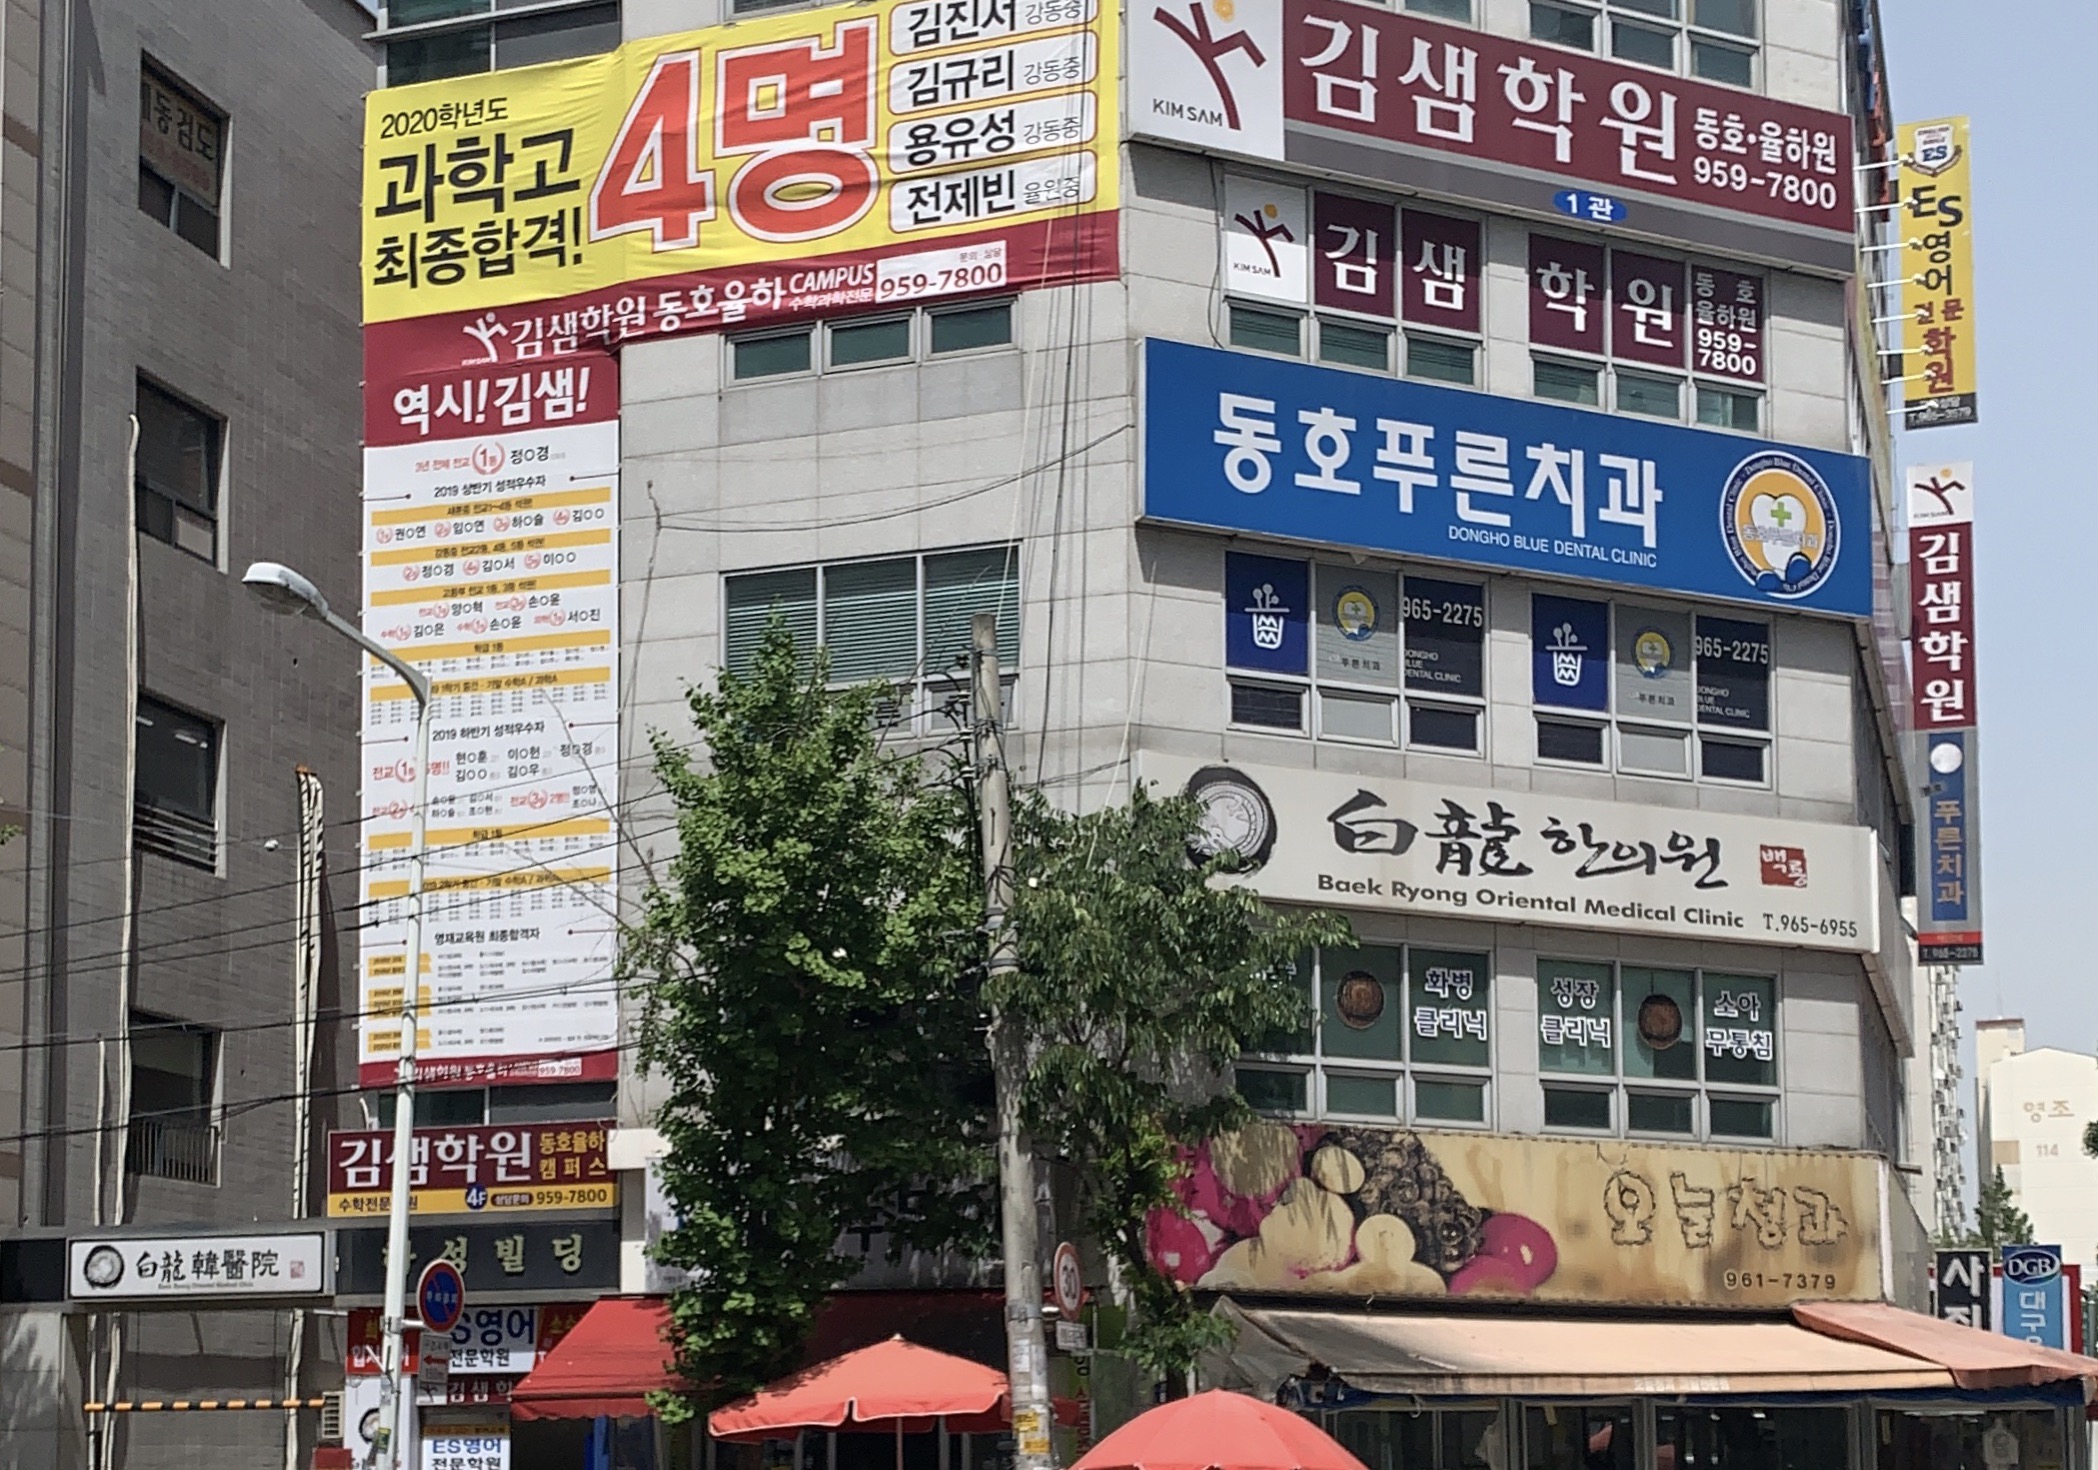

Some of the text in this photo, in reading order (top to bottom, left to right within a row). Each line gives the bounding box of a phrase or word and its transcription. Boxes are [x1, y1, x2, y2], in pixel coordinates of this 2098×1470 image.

[908, 0, 1015, 48] 김진서
[907, 50, 1081, 107] 김규리 강동중
[1300, 13, 1678, 185] 김샘학원
[380, 97, 509, 139] 2020학년도
[588, 13, 880, 254] 4명
[905, 110, 1081, 166] 용유성 강동중
[374, 128, 581, 224] 과학고
[1693, 156, 1837, 210] 959-7800
[907, 170, 1015, 225] 전제빈
[373, 206, 583, 290] 최종합격!
[788, 262, 875, 295] CAMPUS
[880, 262, 1003, 300] 959-7800
[510, 276, 788, 361] 김샘학원 동호율하
[393, 366, 590, 435] 역시! 김샘!
[1213, 392, 1664, 549] 동호푸른치과
[1448, 525, 1658, 568] DONGHO BLUE DENTAL CLINIC
[1403, 596, 1483, 628] 965-2275
[1918, 531, 1969, 723] 김샘학원
[1933, 800, 1965, 905] 푸른치과
[1317, 873, 1745, 929] Baek Ryong Oriental Medical Clinic
[1763, 912, 1858, 938] T.965-6955
[1424, 966, 1473, 1001] 화병
[1551, 976, 1600, 1010] 성장
[1414, 1005, 1488, 1042] 클리닉
[1713, 990, 1761, 1024] 소아
[1540, 1014, 1612, 1049] 클리닉
[1705, 1027, 1774, 1062] 무통침
[539, 1130, 605, 1154] 동호율하
[338, 1194, 418, 1213] 수학전문원
[536, 1188, 607, 1205] 959-7800
[1724, 1272, 1837, 1290] 961-7379
[2007, 1258, 2051, 1277] DGB
[450, 1349, 511, 1368] 전문학원
[432, 1438, 502, 1454] ES영어
